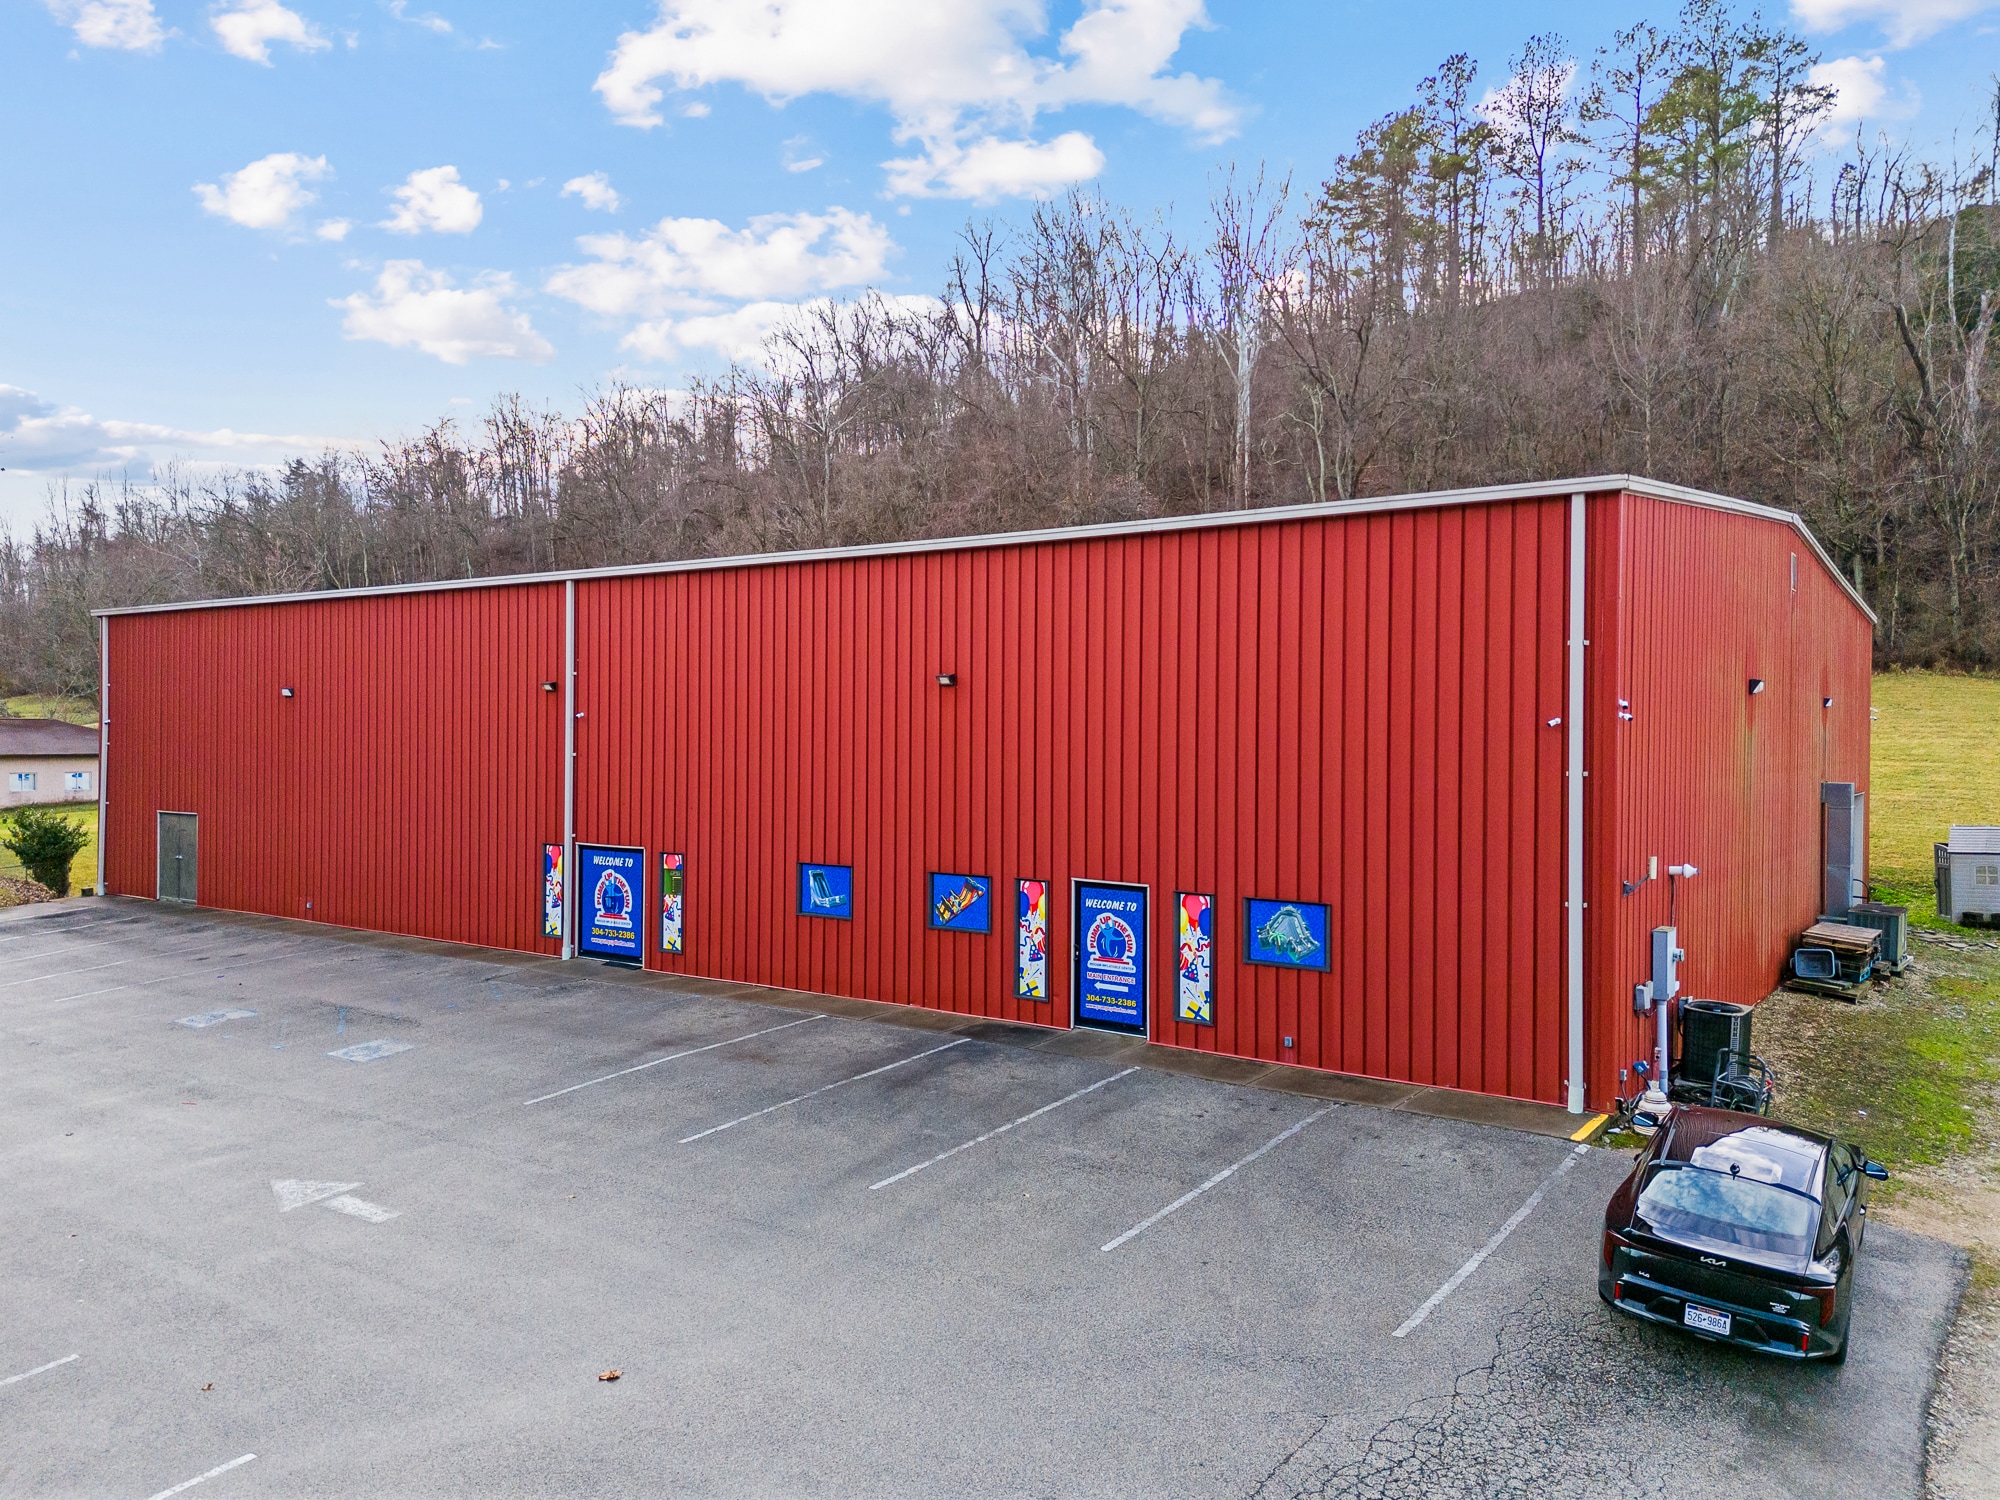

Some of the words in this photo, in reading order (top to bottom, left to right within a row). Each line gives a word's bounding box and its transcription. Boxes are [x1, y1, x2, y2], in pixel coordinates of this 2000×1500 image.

[593, 855, 624, 867] WELCOME
[625, 858, 634, 867] TO
[597, 881, 605, 905] PUMP
[604, 872, 613, 881] UP
[615, 876, 626, 890] THE
[1086, 898, 1125, 910] WELCOME
[1126, 902, 1137, 912] TO
[591, 927, 635, 940] 304-733-2386
[1090, 924, 1100, 949] PUMP
[1099, 916, 1111, 925] UP
[1113, 920, 1128, 934] THE
[1125, 934, 1133, 953] FUN
[1087, 972, 1102, 980] MAIN
[1103, 974, 1135, 985] ENTRANCE
[1086, 994, 1137, 1008] 304-733-2386
